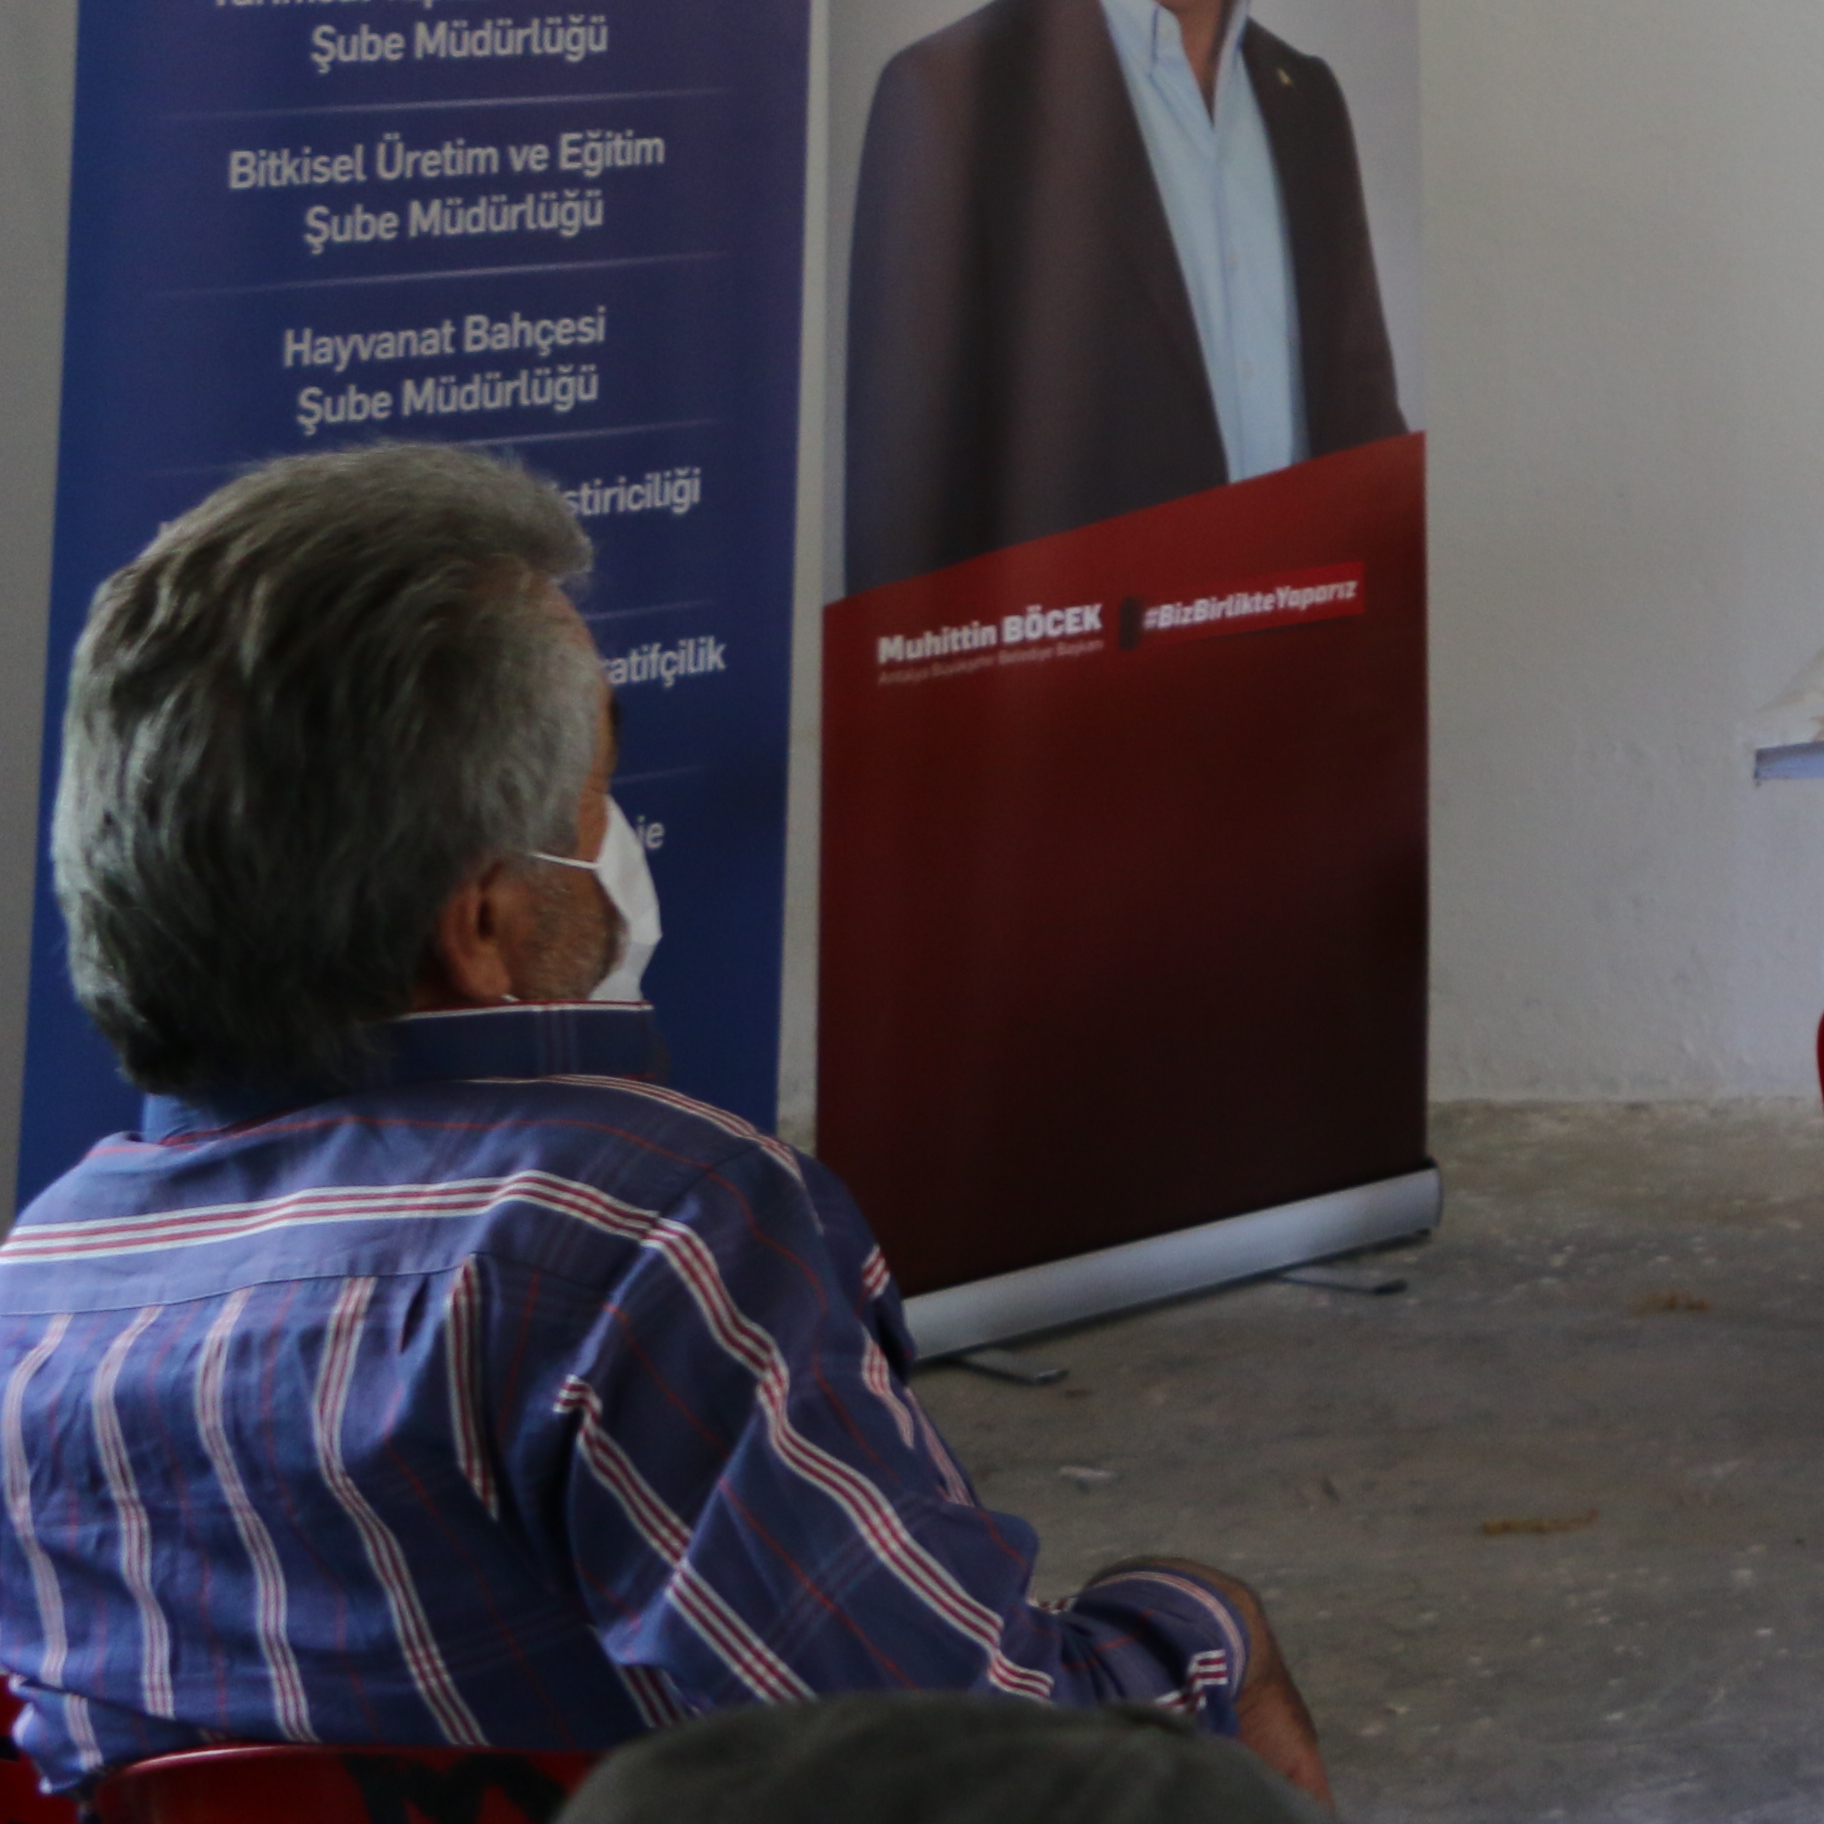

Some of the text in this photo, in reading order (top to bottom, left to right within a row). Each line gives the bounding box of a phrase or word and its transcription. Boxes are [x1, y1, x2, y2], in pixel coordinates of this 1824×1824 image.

[310, 12, 608, 75] Şube Müdürlüğü
[228, 127, 666, 190] Bitkisel Üretim ve Eğitim
[303, 187, 604, 256] Şube Müdürlüğü
[283, 305, 606, 367] Hayvanat Bahçesi
[296, 361, 599, 437] Şube Müdürlüğü
[602, 635, 728, 688] atifçilik
[877, 622, 998, 665] Muhittin
[1002, 604, 1103, 645] BÖCEK
